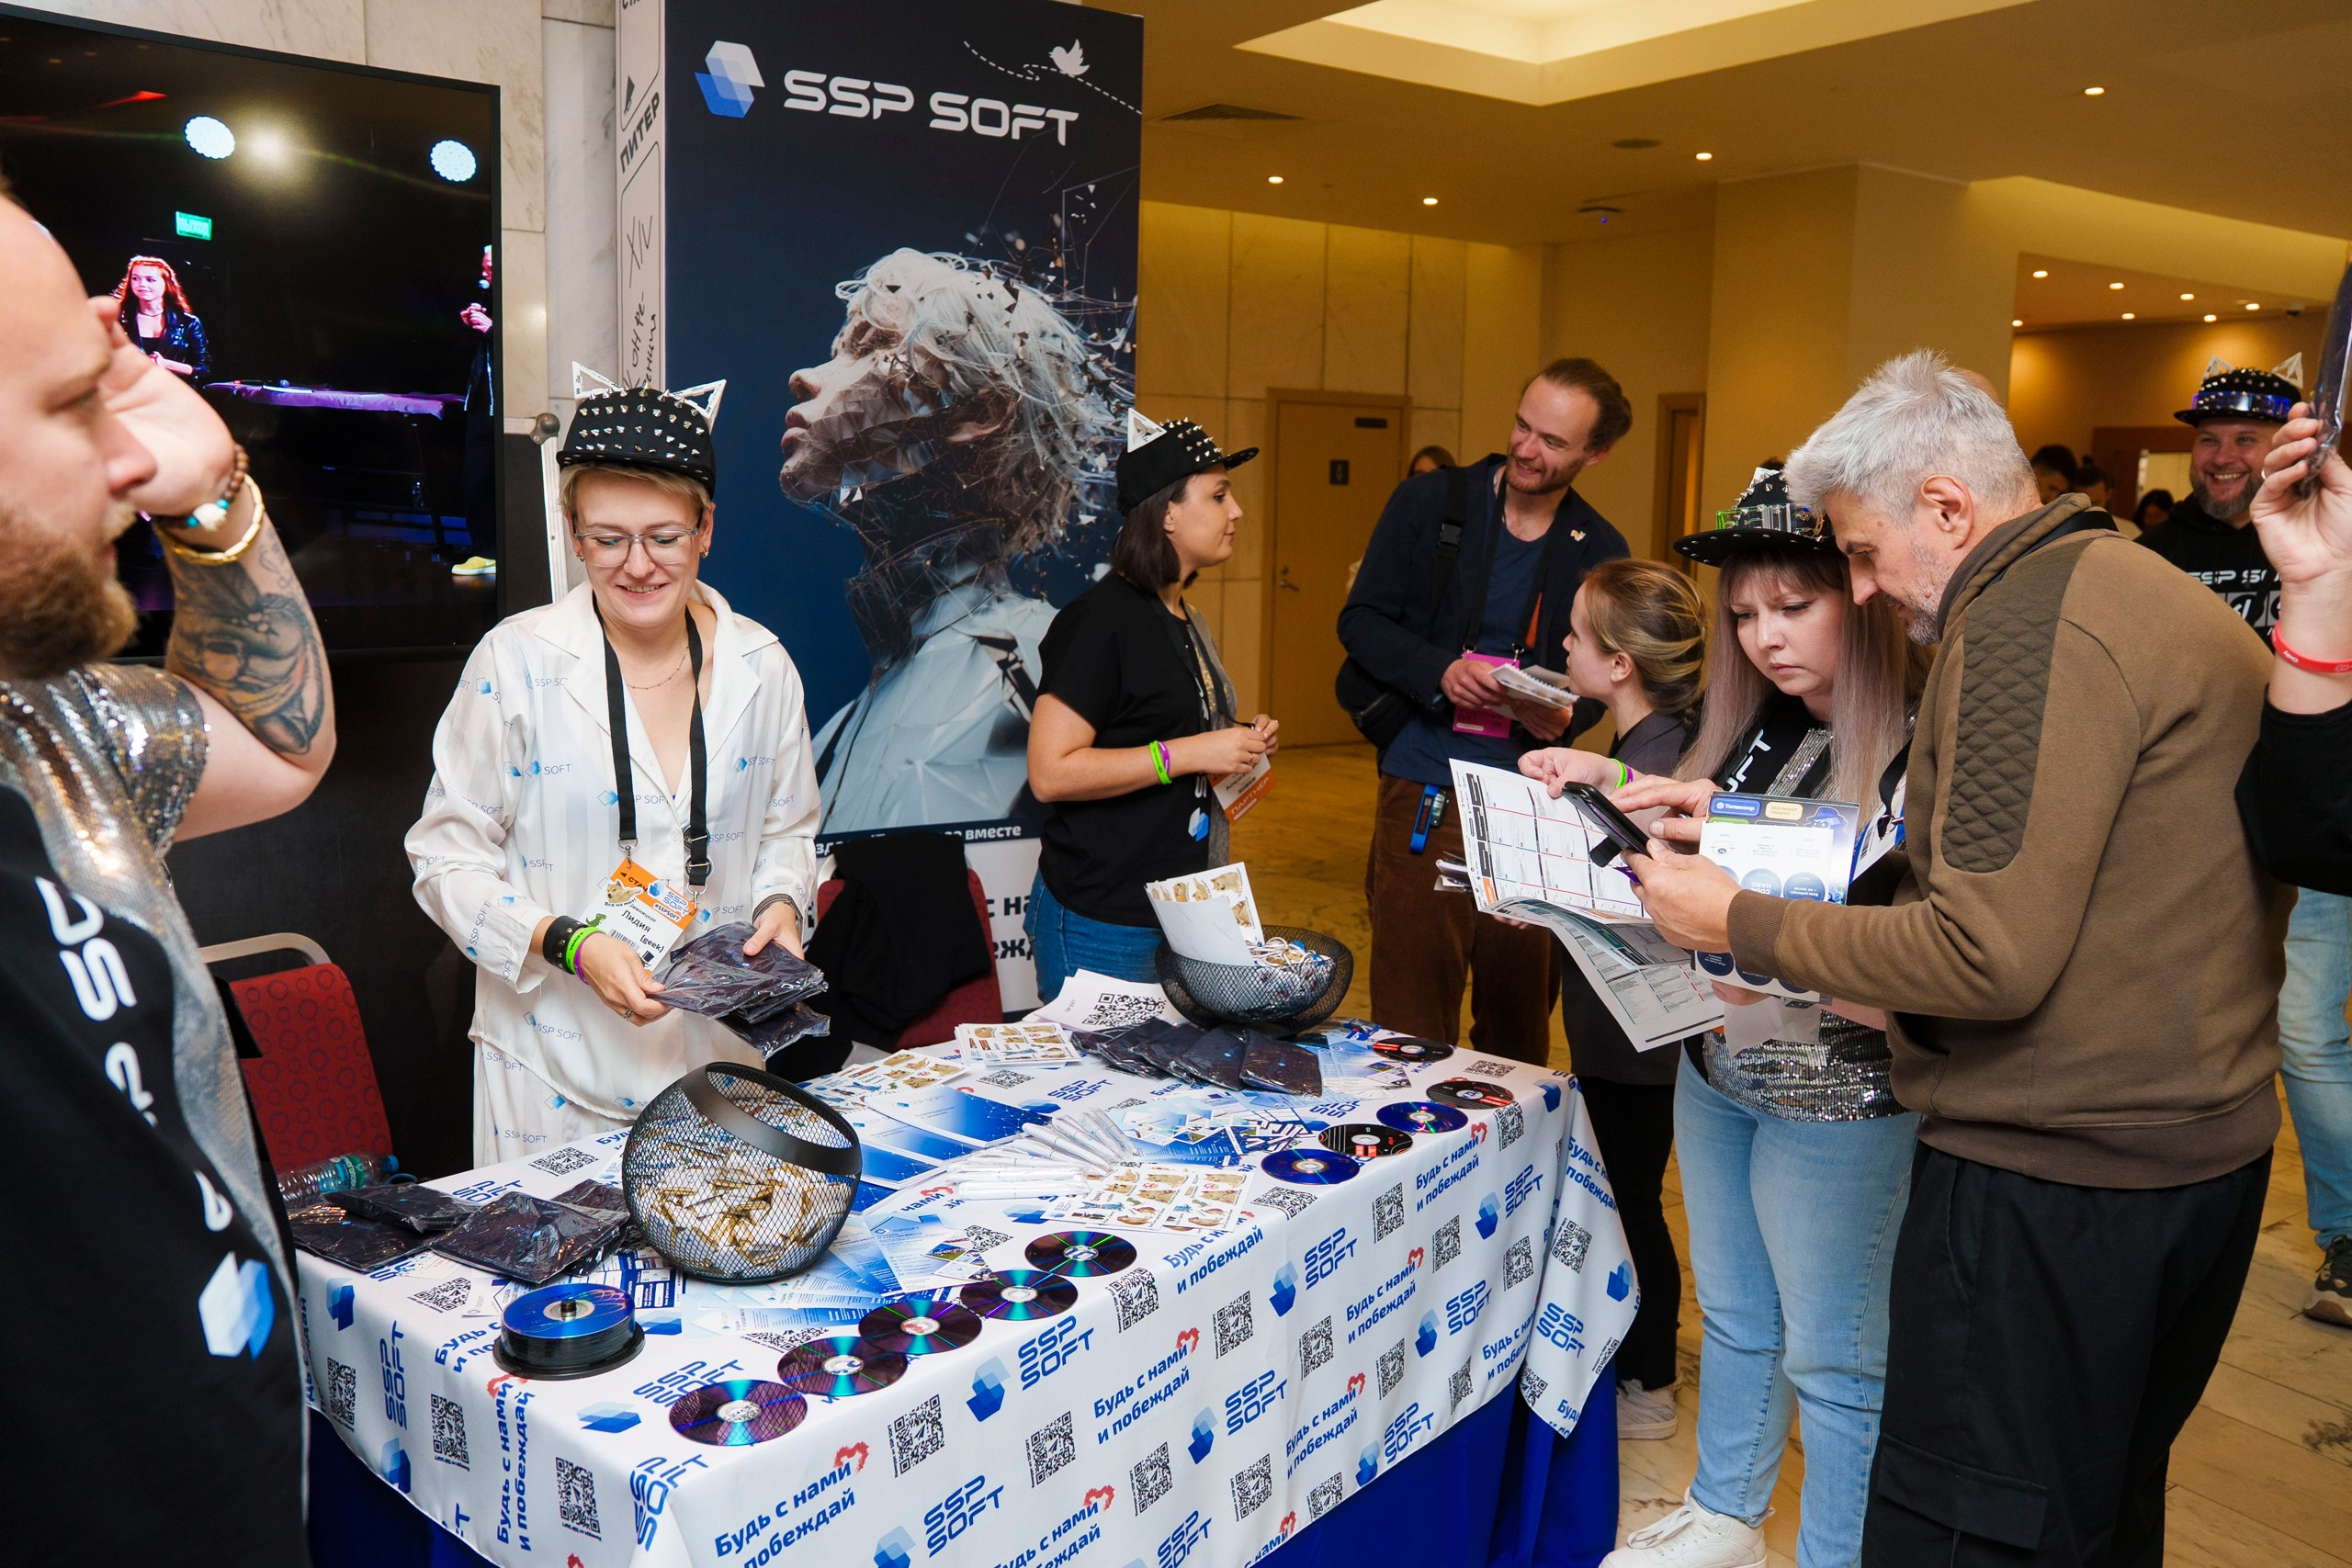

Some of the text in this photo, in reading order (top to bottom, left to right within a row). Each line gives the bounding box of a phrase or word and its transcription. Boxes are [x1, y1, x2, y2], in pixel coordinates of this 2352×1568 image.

[784, 70, 1080, 146] SSP SOFT
[620, 92, 660, 174] ПИТЕР
[535, 678, 552, 687] SSP
[544, 763, 571, 774] SOFT
[726, 832, 744, 841] SOFT
[965, 826, 1021, 840] вместе
[628, 877, 648, 893] СТАЧ
[662, 897, 688, 915] SOFT
[666, 891, 687, 907] SSP
[621, 910, 650, 932] Лидия
[654, 904, 681, 921] #SSPSOFT
[722, 906, 744, 915] SOFT
[537, 1022, 582, 1042] SSP SOFT
[1047, 1080, 1088, 1098] SSP
[1062, 1079, 1114, 1101] SOFT
[504, 1130, 547, 1144] SSP SOFT
[1416, 1135, 1479, 1190] Будь с нами
[1417, 1154, 1479, 1213] и побеждай
[1505, 1164, 1533, 1201] SSP
[1505, 1174, 1544, 1219] SOFT
[1163, 1241, 1204, 1269] Будь
[1205, 1234, 1215, 1244] с
[1176, 1225, 1264, 1294] и побеждай
[1305, 1227, 1346, 1271] SSP
[1305, 1237, 1358, 1291] SOFT
[1346, 1260, 1416, 1322] Будь с нами
[1348, 1280, 1416, 1344] и побеждай
[1446, 1280, 1486, 1317] SSP
[1447, 1288, 1492, 1336] SOFT
[1018, 1315, 1077, 1368] SSP
[1536, 1316, 1585, 1359] SOFT
[1544, 1303, 1584, 1334] SSP
[435, 1327, 486, 1366] Будь
[454, 1357, 467, 1373] и
[1020, 1328, 1094, 1392] SOFT
[1482, 1337, 1512, 1360] Будь
[1514, 1328, 1520, 1339] с
[379, 1337, 398, 1424] SSP
[391, 1320, 408, 1431] SOFT
[633, 1360, 707, 1399] SSP
[1093, 1344, 1188, 1419] Будь с нами
[1225, 1370, 1275, 1416] SSP
[1487, 1371, 1495, 1381] и
[1097, 1366, 1190, 1445] и побеждай
[1227, 1379, 1287, 1436] SOFT
[1286, 1388, 1357, 1458] Будь с нами
[1385, 1402, 1419, 1445] SSP
[1295, 1406, 1358, 1471] побеждай
[1385, 1412, 1434, 1465] SOFT
[496, 1382, 514, 1544] Будь с нами
[514, 1392, 536, 1551] и побеждай
[715, 1461, 852, 1557] Будь с нами
[743, 1487, 855, 1568] побеждай
[923, 1474, 986, 1535] SSP
[926, 1485, 1004, 1558] SOFT
[1039, 1537, 1049, 1551] с
[1052, 1502, 1099, 1543] нами
[1157, 1510, 1199, 1565] SSP
